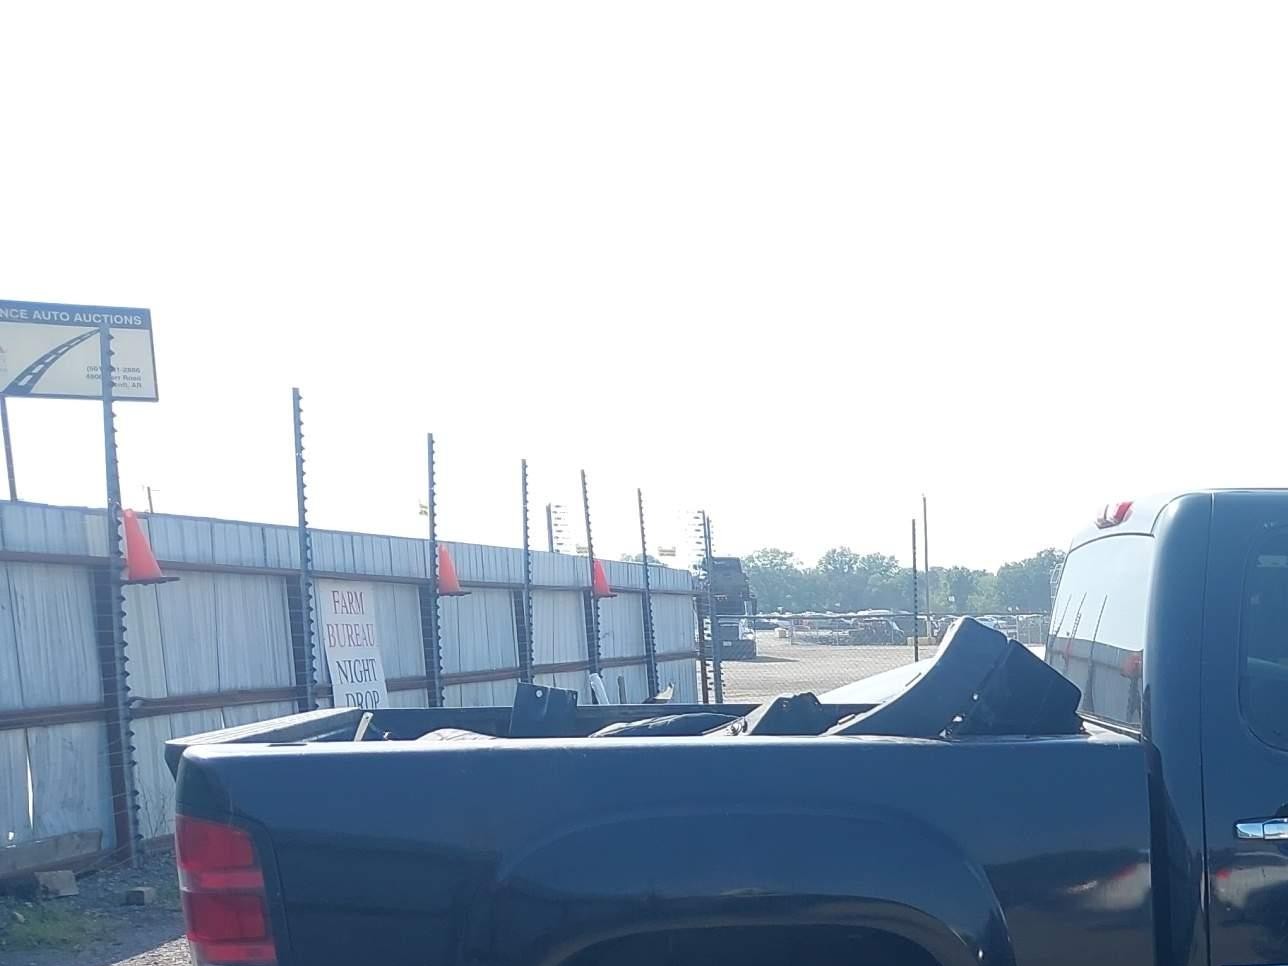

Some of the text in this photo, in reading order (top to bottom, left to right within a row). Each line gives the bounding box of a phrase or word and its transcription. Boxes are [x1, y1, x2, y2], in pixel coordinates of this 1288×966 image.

[32, 310, 70, 322] AUTO
[73, 313, 143, 326] AUCTIONS
[331, 590, 365, 615] FARM
[326, 623, 376, 648] BUREAU
[336, 659, 378, 684] NIGHT
[345, 690, 380, 709] DROP
